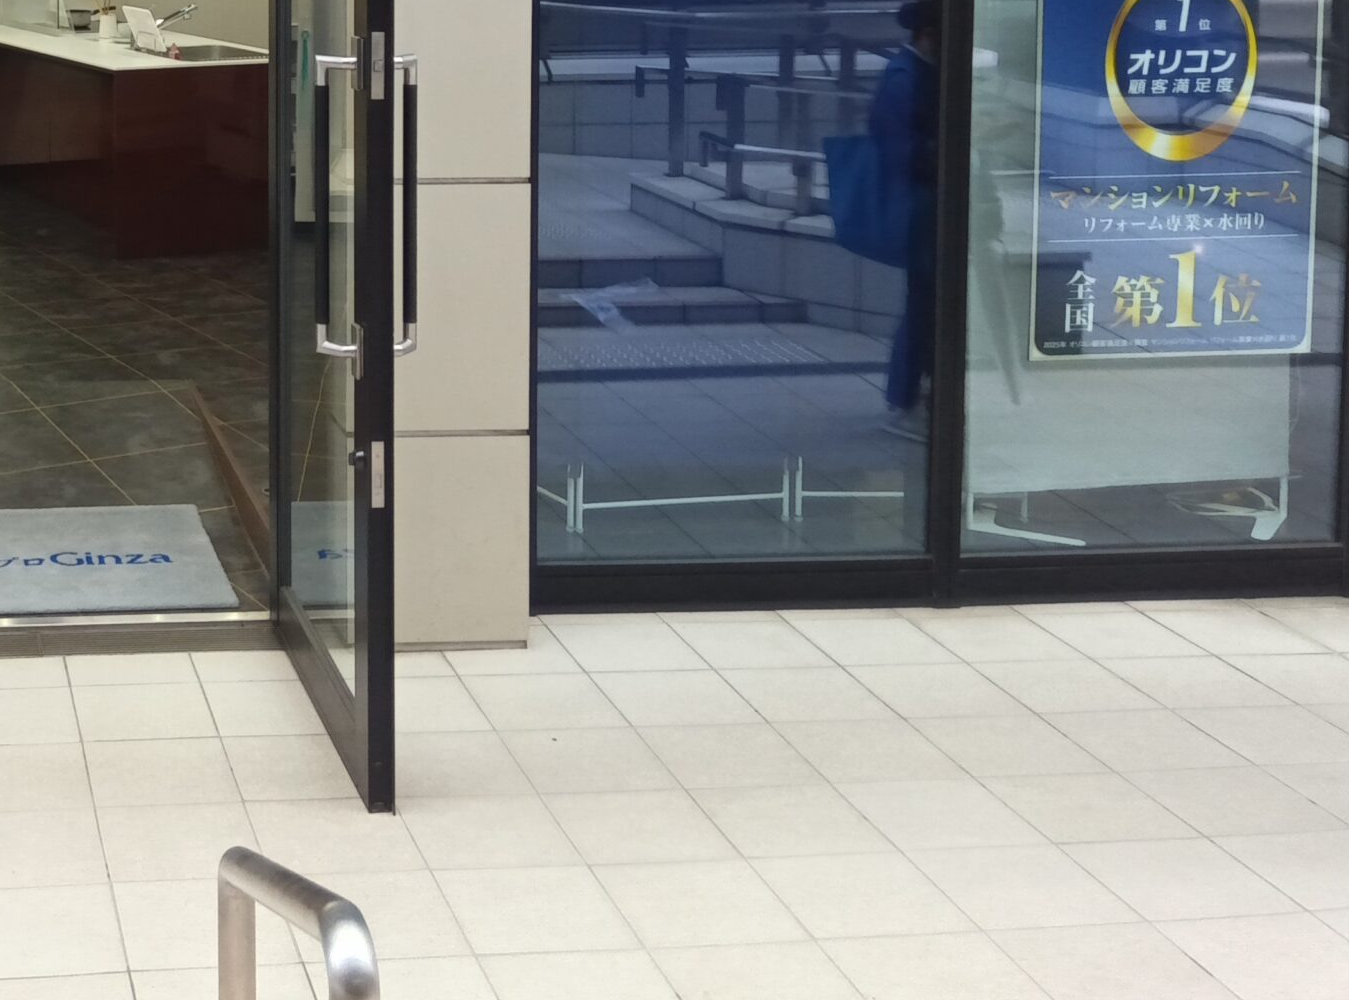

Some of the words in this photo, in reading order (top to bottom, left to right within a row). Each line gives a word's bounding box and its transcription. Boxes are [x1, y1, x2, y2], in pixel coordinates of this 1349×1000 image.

[1127, 49, 1237, 75] オリコン
[1128, 78, 1234, 95] 顧客満足度
[1050, 181, 1298, 211] マンションリフォーム
[1064, 269, 1097, 333] 全国
[1110, 250, 1262, 329] 第1位
